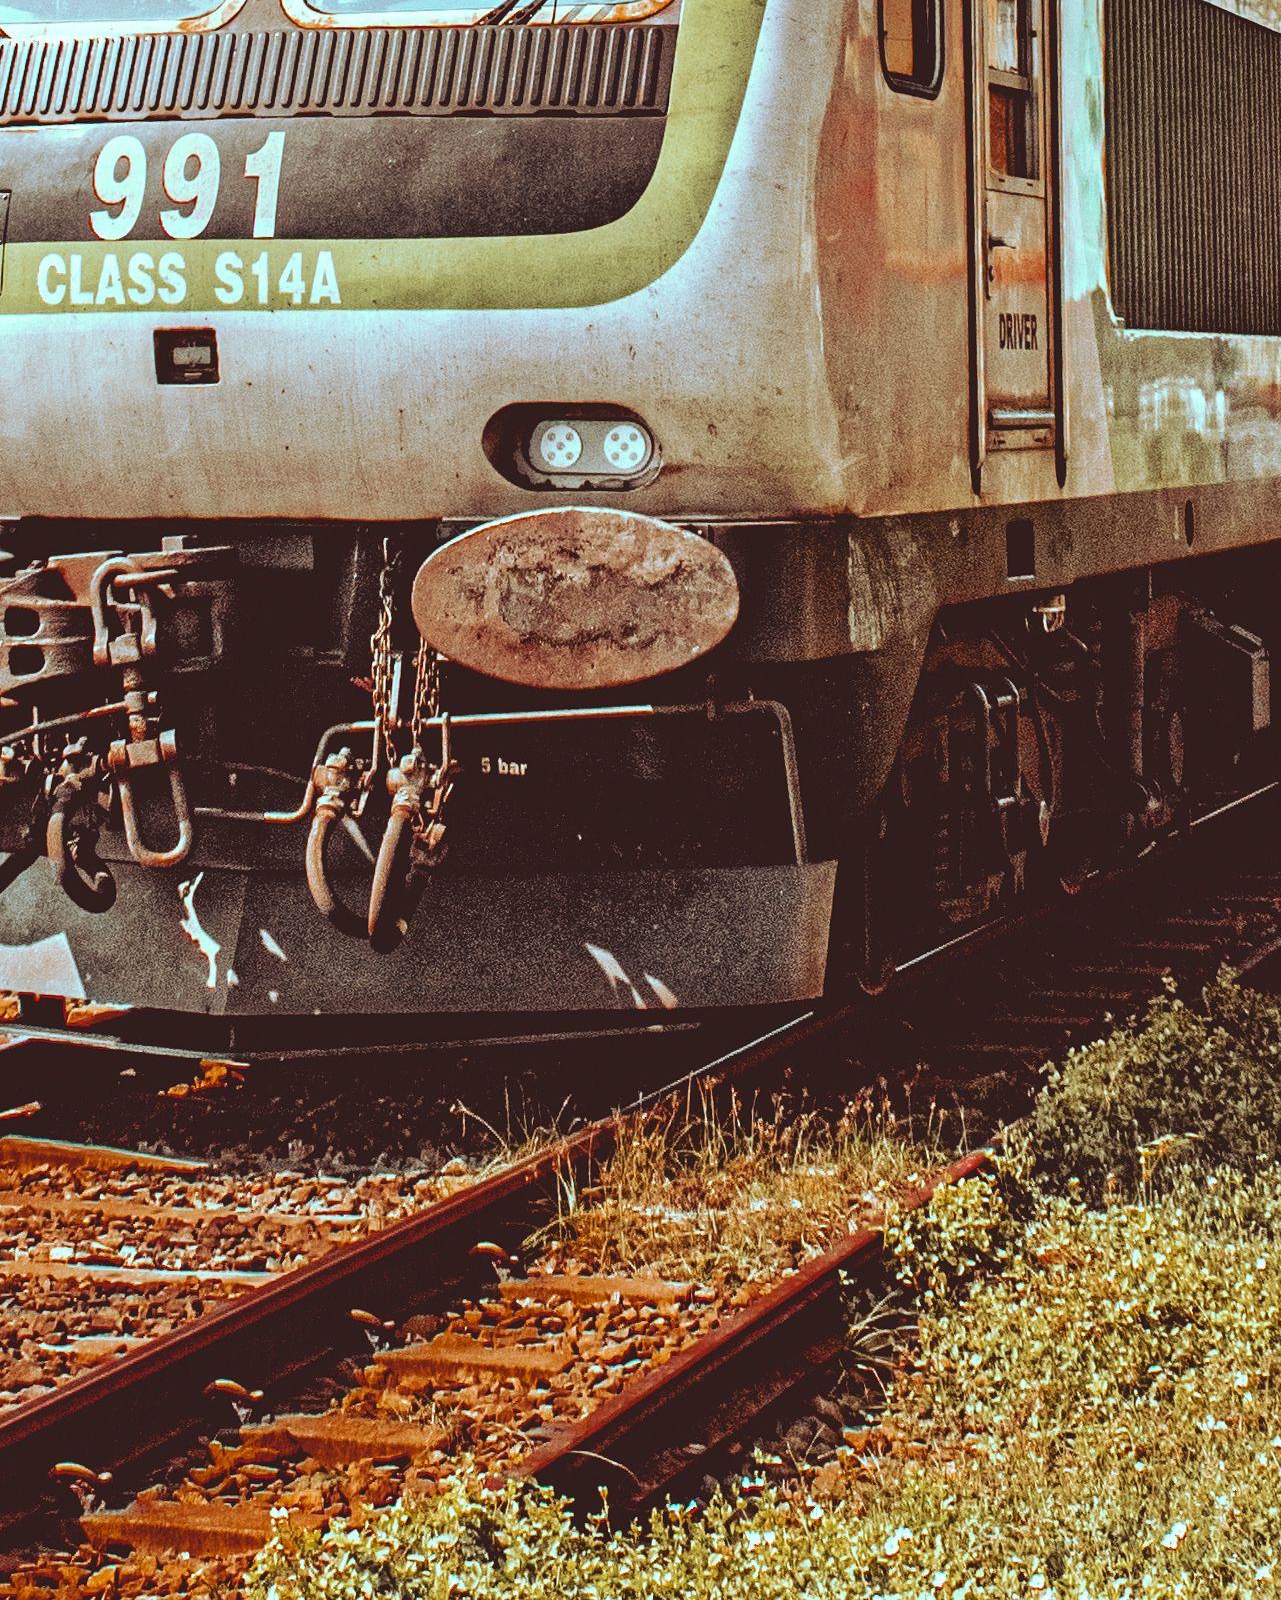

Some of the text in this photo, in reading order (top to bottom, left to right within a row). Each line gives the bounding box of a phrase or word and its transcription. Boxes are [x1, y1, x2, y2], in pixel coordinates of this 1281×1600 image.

[89, 131, 286, 240] 991
[37, 251, 341, 306] CLASS S14A
[998, 313, 1038, 350] DRIVER
[481, 757, 528, 776] 5 bar
